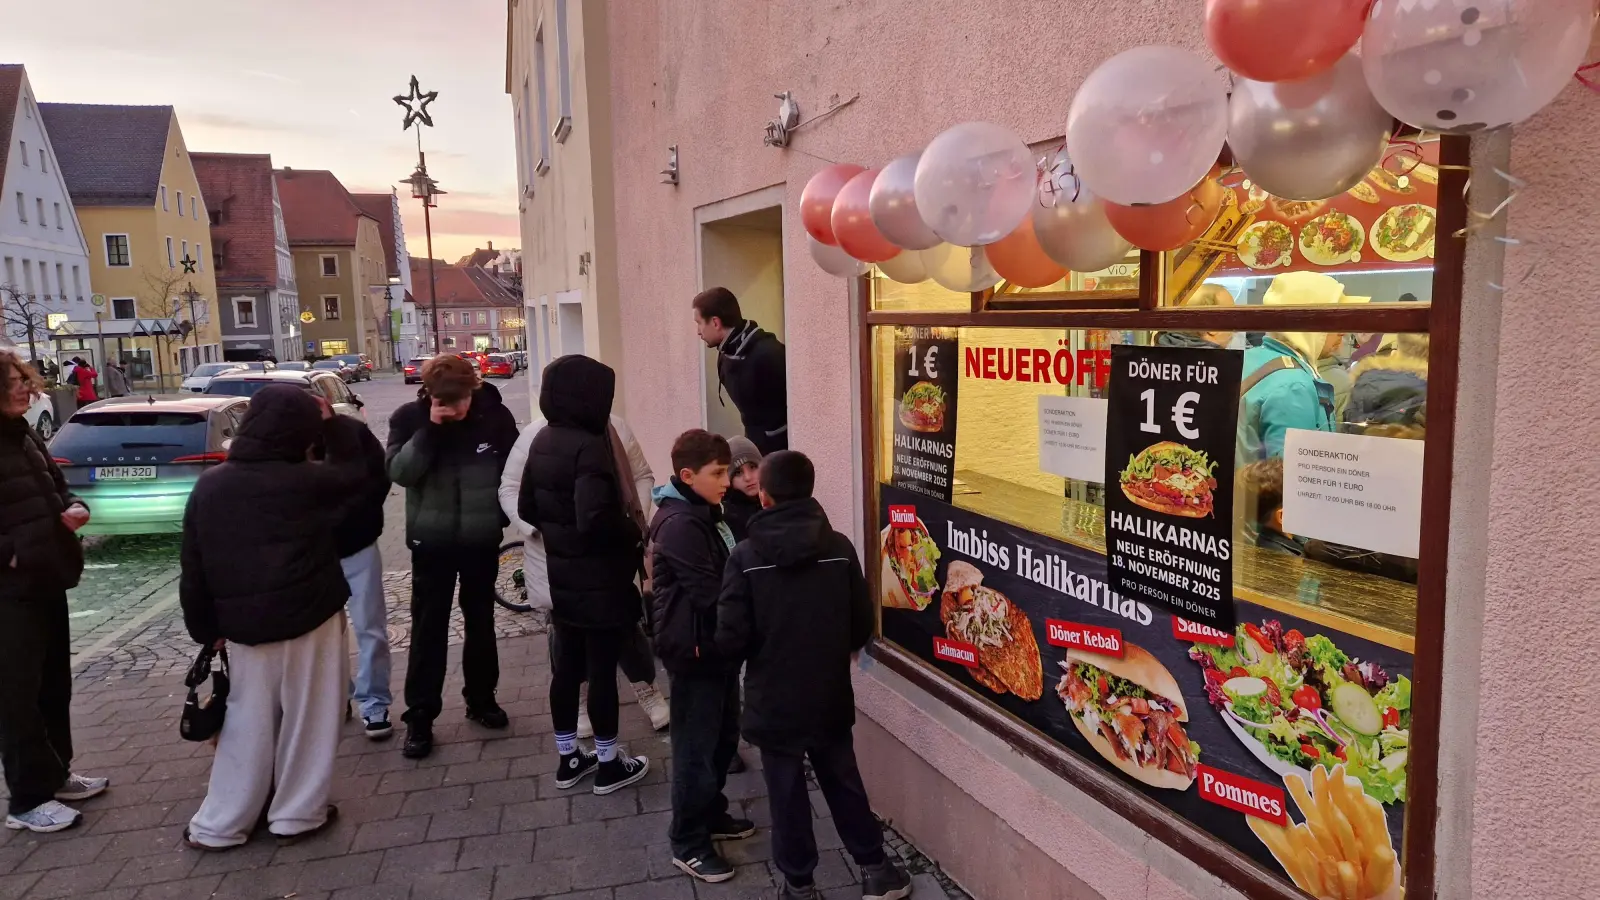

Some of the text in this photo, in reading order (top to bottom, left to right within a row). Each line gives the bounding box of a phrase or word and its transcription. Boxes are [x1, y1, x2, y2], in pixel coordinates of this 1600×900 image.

[908, 345, 939, 379] 1 €
[965, 339, 1112, 388] NEUERÖFF
[1128, 357, 1219, 385] DÖNER FÜR
[1140, 388, 1201, 440] 1 €
[894, 433, 953, 459] HALIKARNAS
[1297, 448, 1359, 462] SONDERAKTION
[100, 467, 152, 478] AM H 320
[896, 453, 948, 475] NEUE ERÖFFNUNG
[1298, 462, 1370, 478] PRO PERSON EIN DÖNER
[897, 481, 907, 489] PRO
[907, 483, 924, 495] PERSON
[931, 489, 945, 500] DÖNER
[901, 467, 933, 483] NOVEMBER
[933, 474, 947, 488] 2025
[1322, 478, 1337, 488] FÜR
[1343, 482, 1364, 492] EURO
[891, 508, 915, 523] Dürüm
[1382, 504, 1397, 512] UHR
[1110, 510, 1230, 561] HALIKARNAS
[946, 519, 1153, 626] Imbiss Halikarnas
[1116, 538, 1221, 583] NEUE ERÖFFNUNG
[1112, 554, 1221, 601] 18. NOVEMBER 2025
[1121, 577, 1217, 619] PRO PERSON EIN DÖNER
[1049, 624, 1120, 651] Döner Kebab
[936, 641, 975, 663] Lahmacun
[1202, 772, 1282, 817] Pommes
